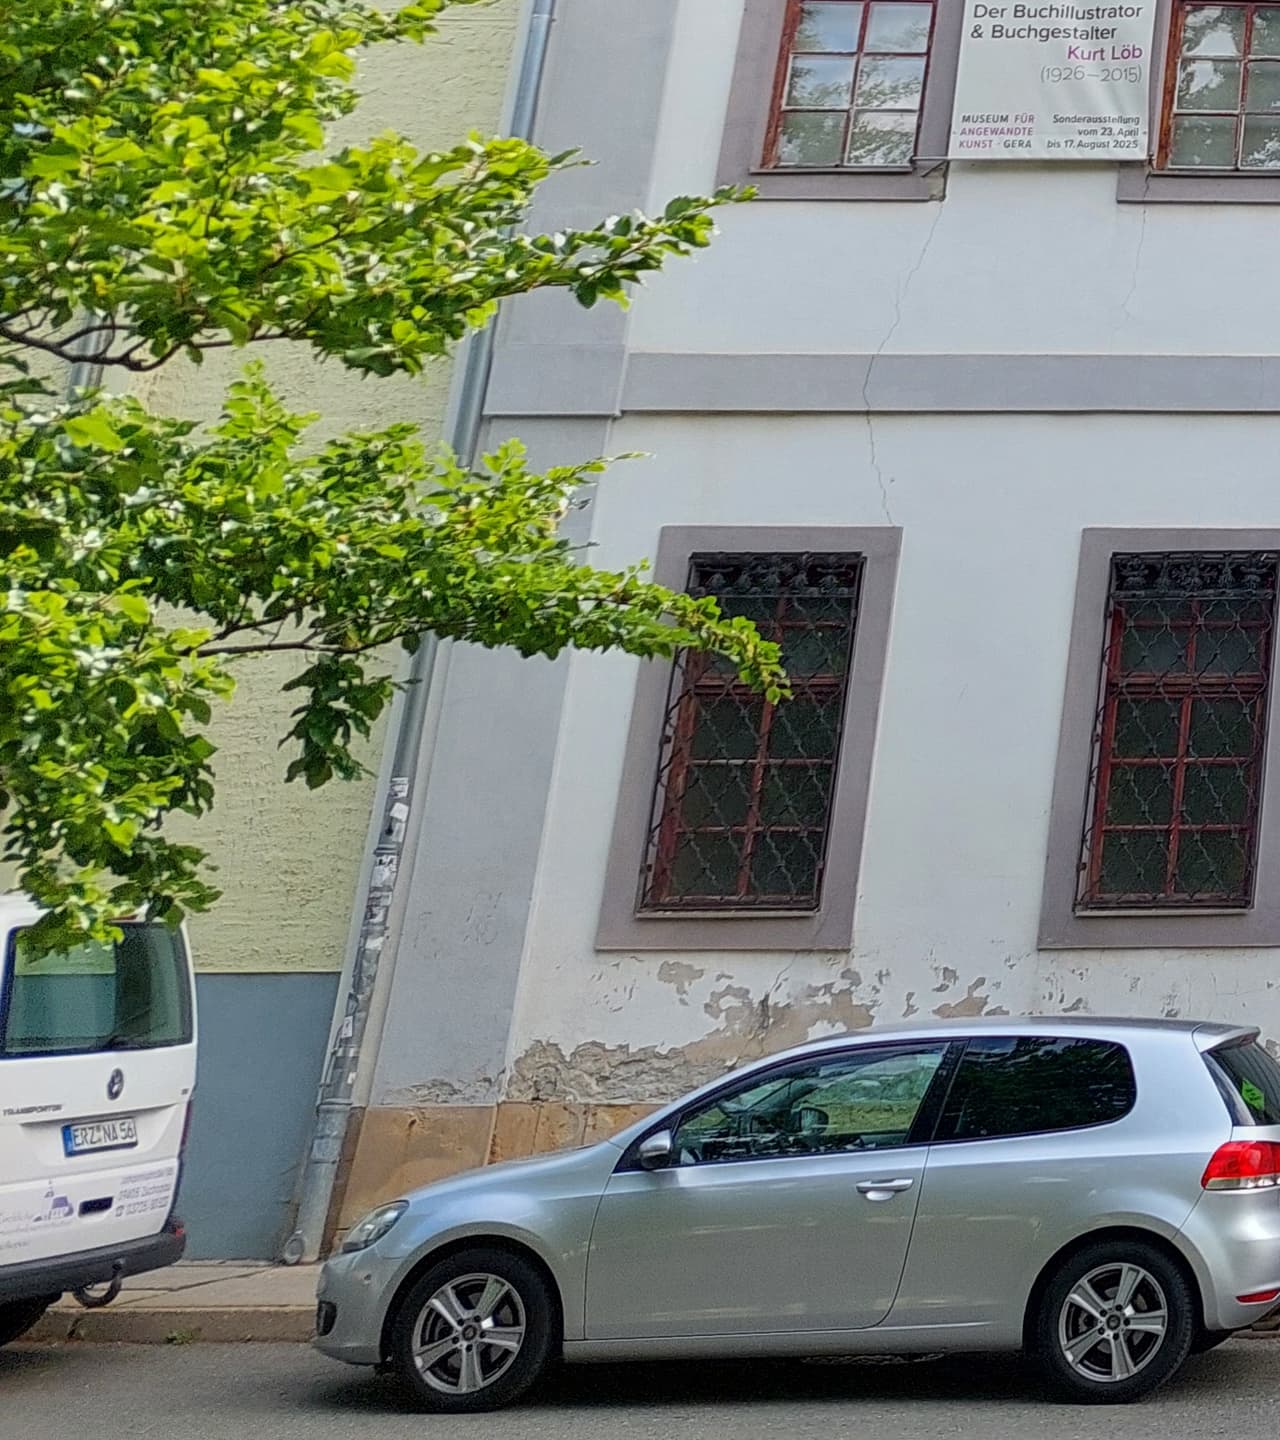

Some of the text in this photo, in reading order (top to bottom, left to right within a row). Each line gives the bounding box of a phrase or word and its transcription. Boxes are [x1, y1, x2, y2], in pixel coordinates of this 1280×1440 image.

[973, 3, 1143, 20] Der Buchillustrator
[970, 24, 1117, 42] & Buchgestalter
[1067, 44, 1143, 60] Kurt Löb
[961, 112, 1035, 124] MUSEUM FÜR
[1052, 114, 1140, 126] Sonderausstellung
[960, 126, 1033, 137] ANGEWANDTE
[1078, 126, 1139, 138] vom 23. April
[959, 139, 1032, 149] KUNST GERA
[1047, 139, 1061, 149] bis
[1077, 139, 1110, 151] August
[1112, 139, 1138, 149] 2025
[72, 1120, 134, 1146] ERZ NA 56
